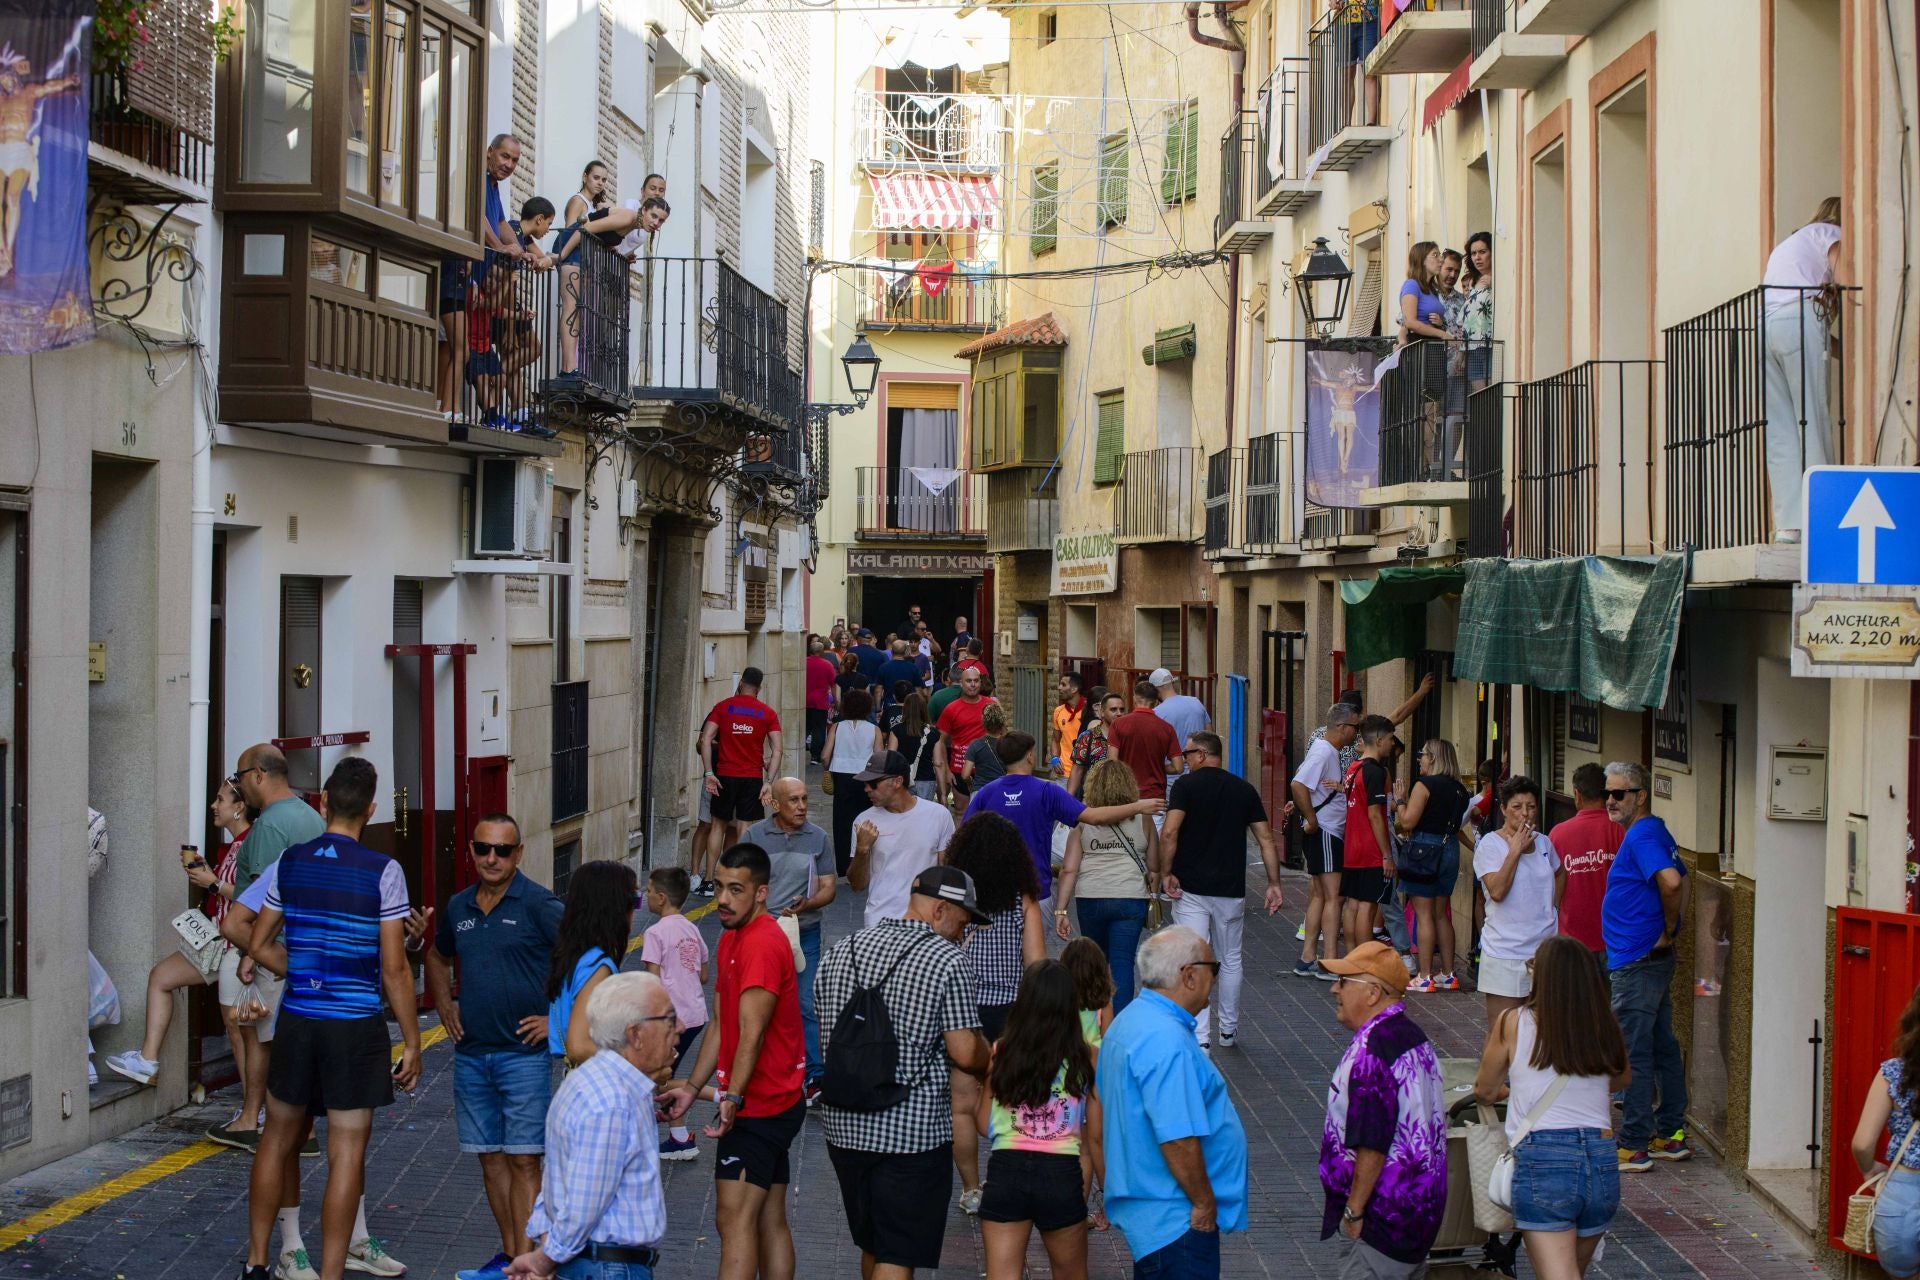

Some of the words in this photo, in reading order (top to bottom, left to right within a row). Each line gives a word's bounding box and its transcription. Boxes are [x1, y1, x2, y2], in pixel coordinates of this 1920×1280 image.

[122, 422, 136, 446] 56
[224, 493, 236, 516] 54
[1056, 537, 1079, 562] CASA
[1081, 533, 1115, 559] OLIVOS
[850, 554, 996, 569] KALAMOTXANA
[1824, 614, 1900, 627] ANCHURA
[1807, 632, 1844, 645] MAX.
[1850, 631, 1892, 647] 2,20
[732, 723, 754, 732] beko
[311, 736, 325, 747] LOCAL
[325, 734, 344, 746] PRIVADO
[186, 915, 210, 940] TOUS
[456, 918, 476, 932] SQN
